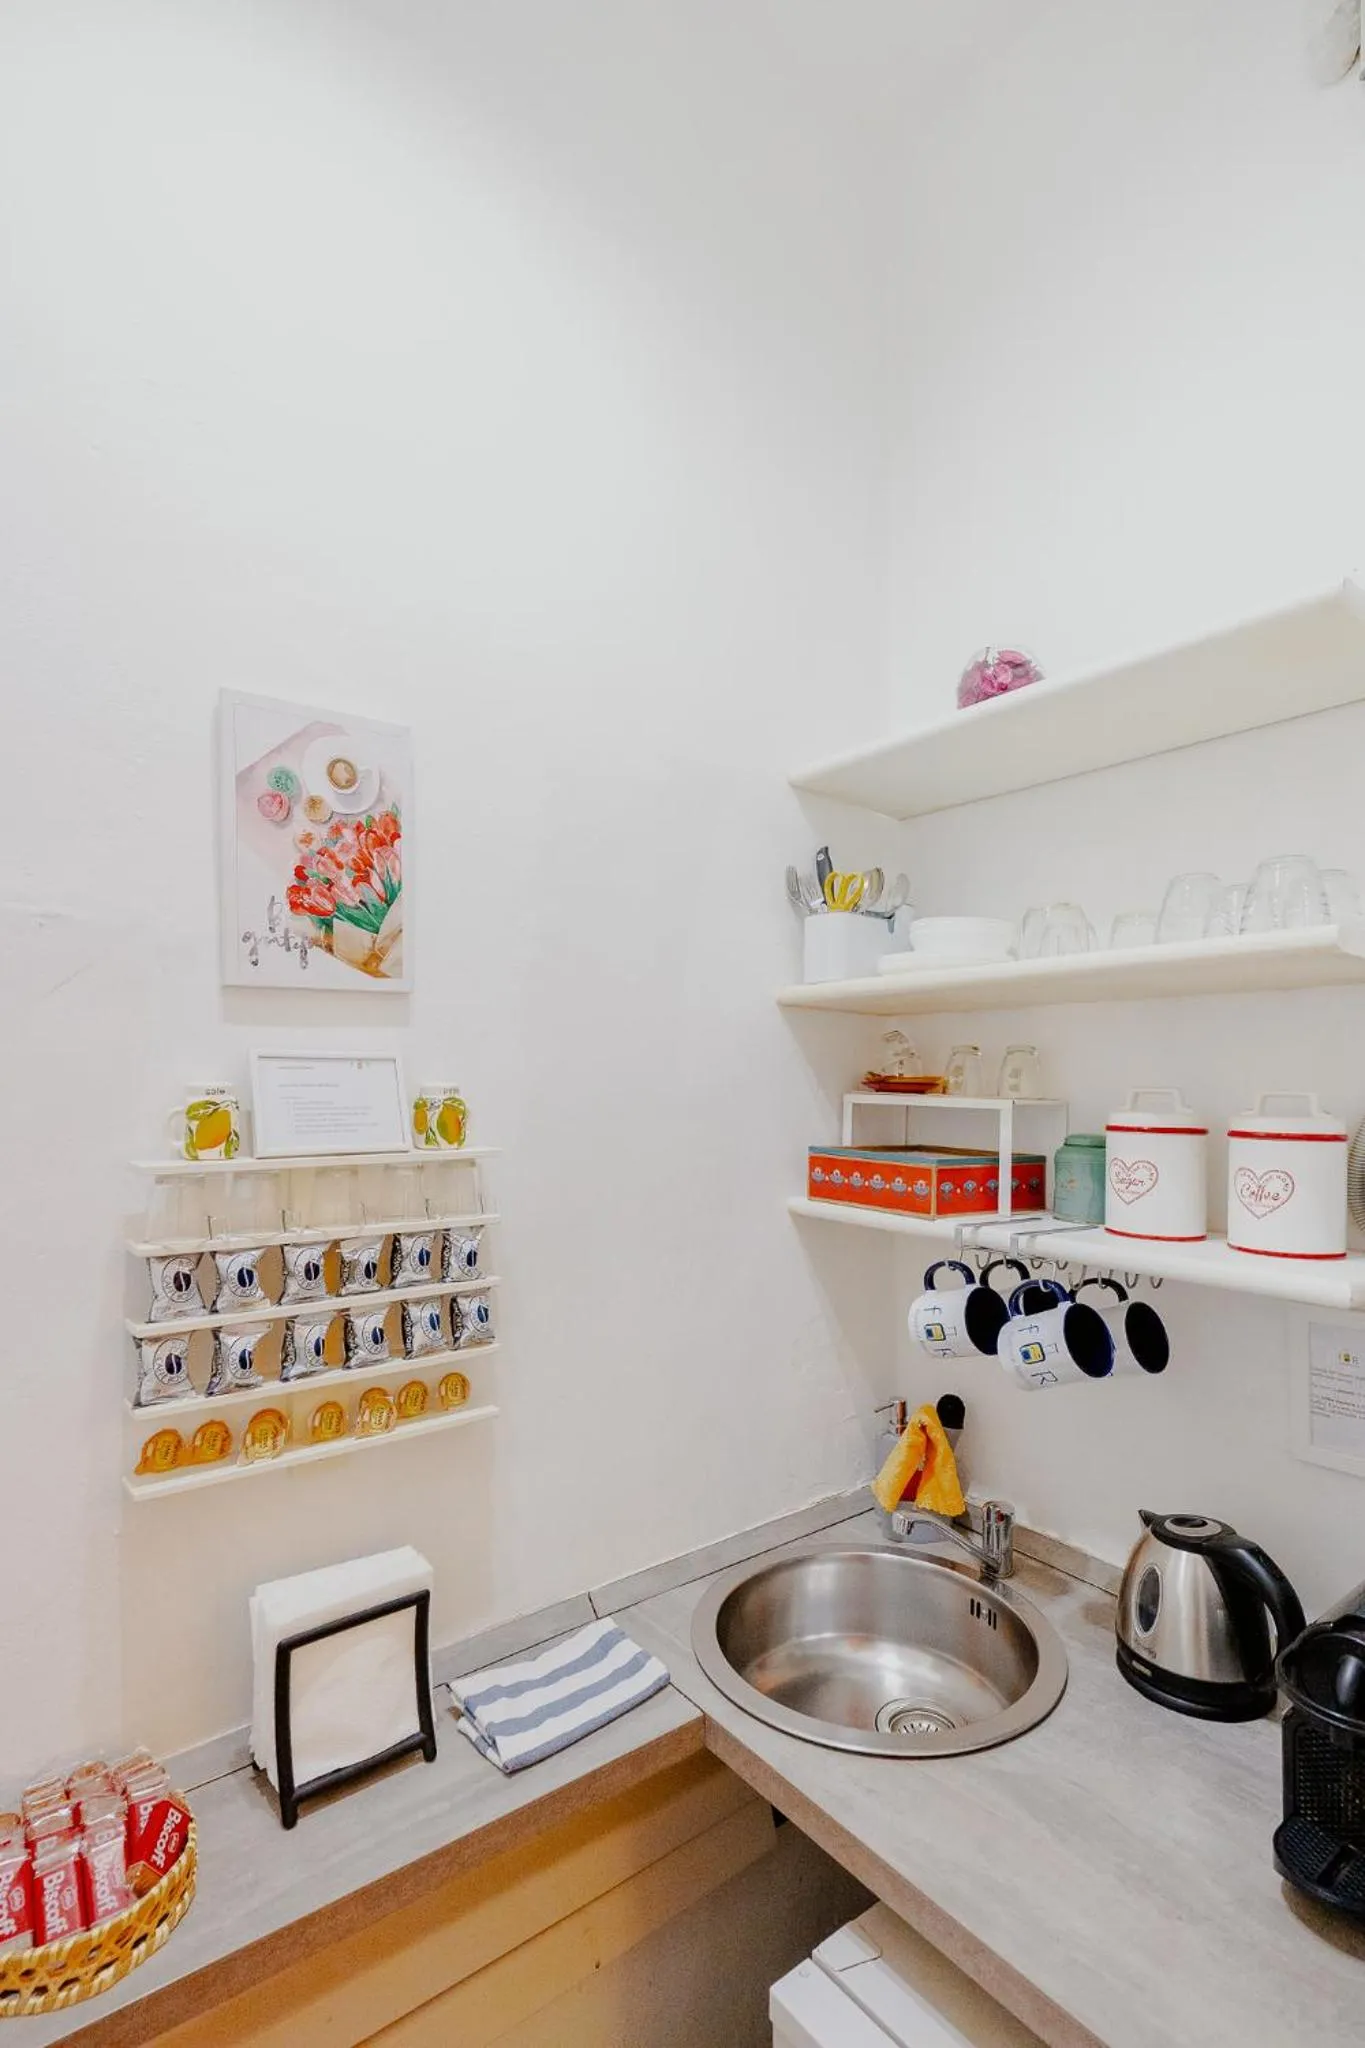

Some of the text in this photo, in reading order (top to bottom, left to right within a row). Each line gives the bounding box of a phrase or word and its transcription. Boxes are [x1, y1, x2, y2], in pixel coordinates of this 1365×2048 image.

[1240, 1183, 1281, 1202] Coffee
[151, 1807, 182, 1869] Biscoff
[43, 1871, 69, 1941] Biscoff
